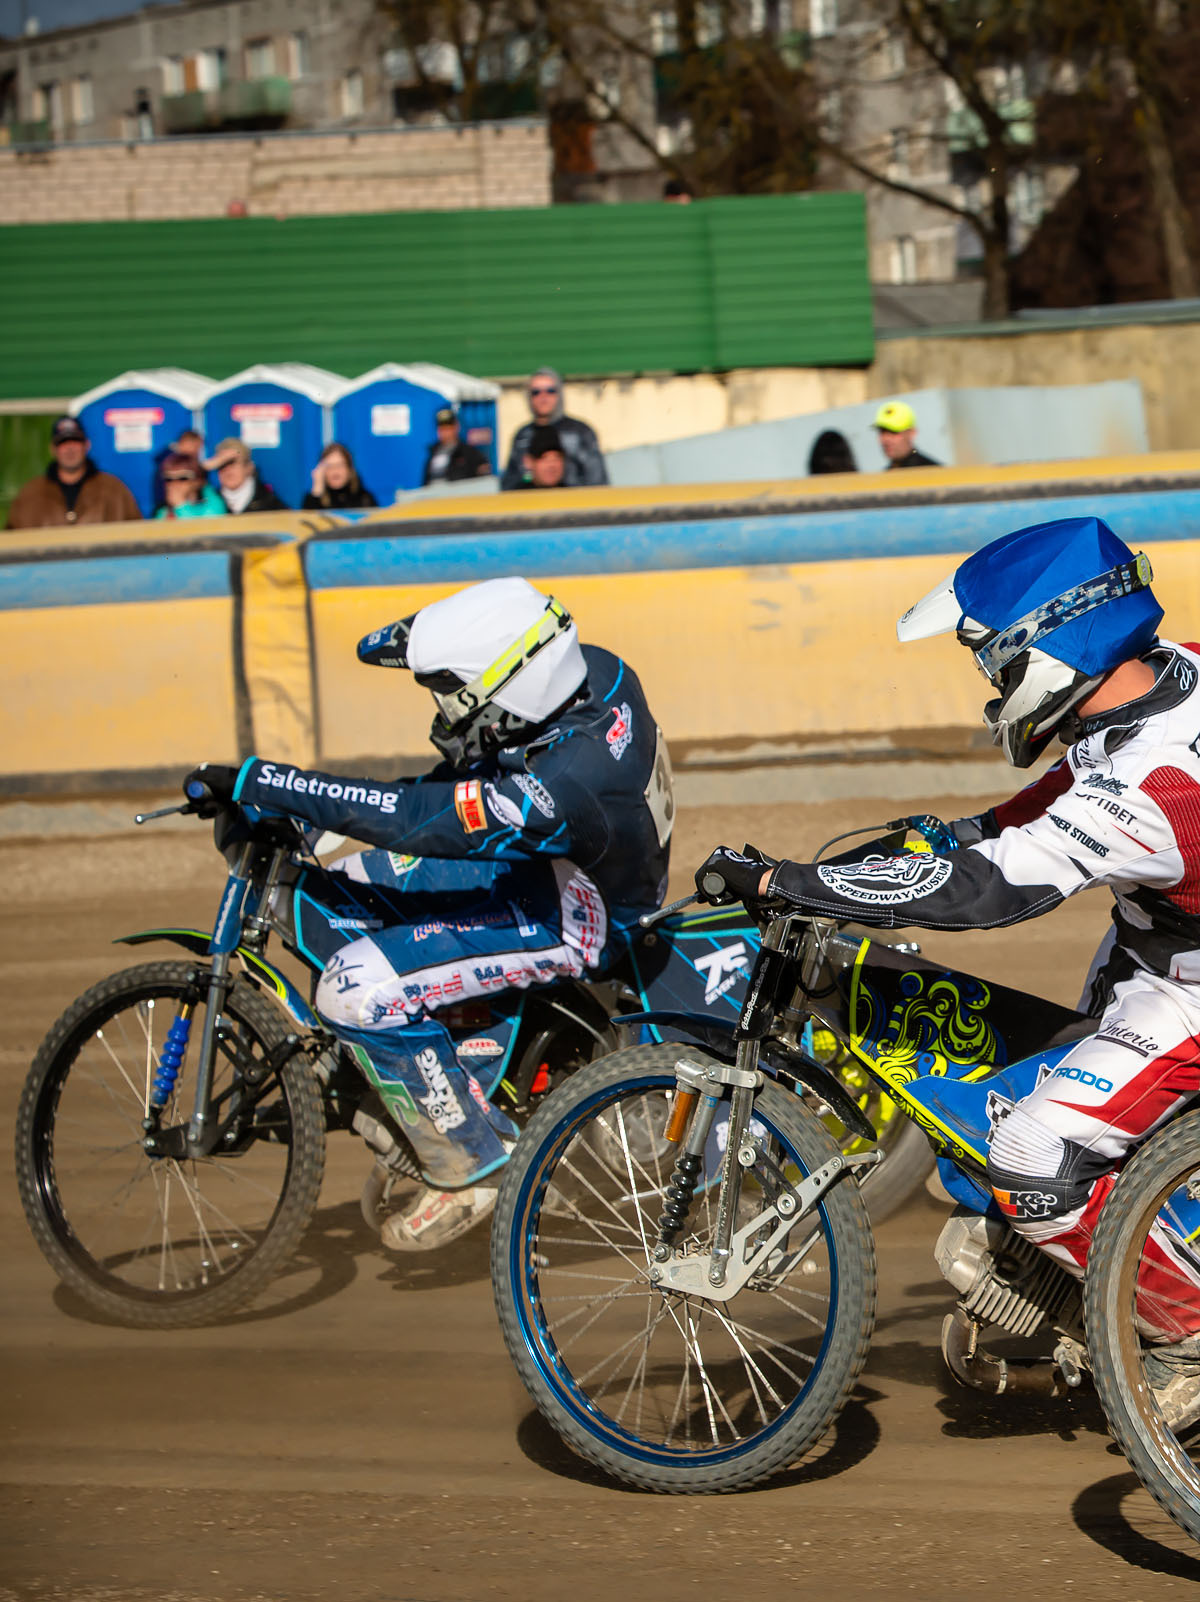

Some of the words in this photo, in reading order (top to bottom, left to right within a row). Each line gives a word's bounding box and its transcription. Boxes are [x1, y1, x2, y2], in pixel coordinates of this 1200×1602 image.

[257, 764, 399, 814] Saletromag
[1070, 828, 1110, 858] STUDIOS
[835, 883, 911, 902] SPEEDWAY
[916, 861, 951, 899] MUSEUM
